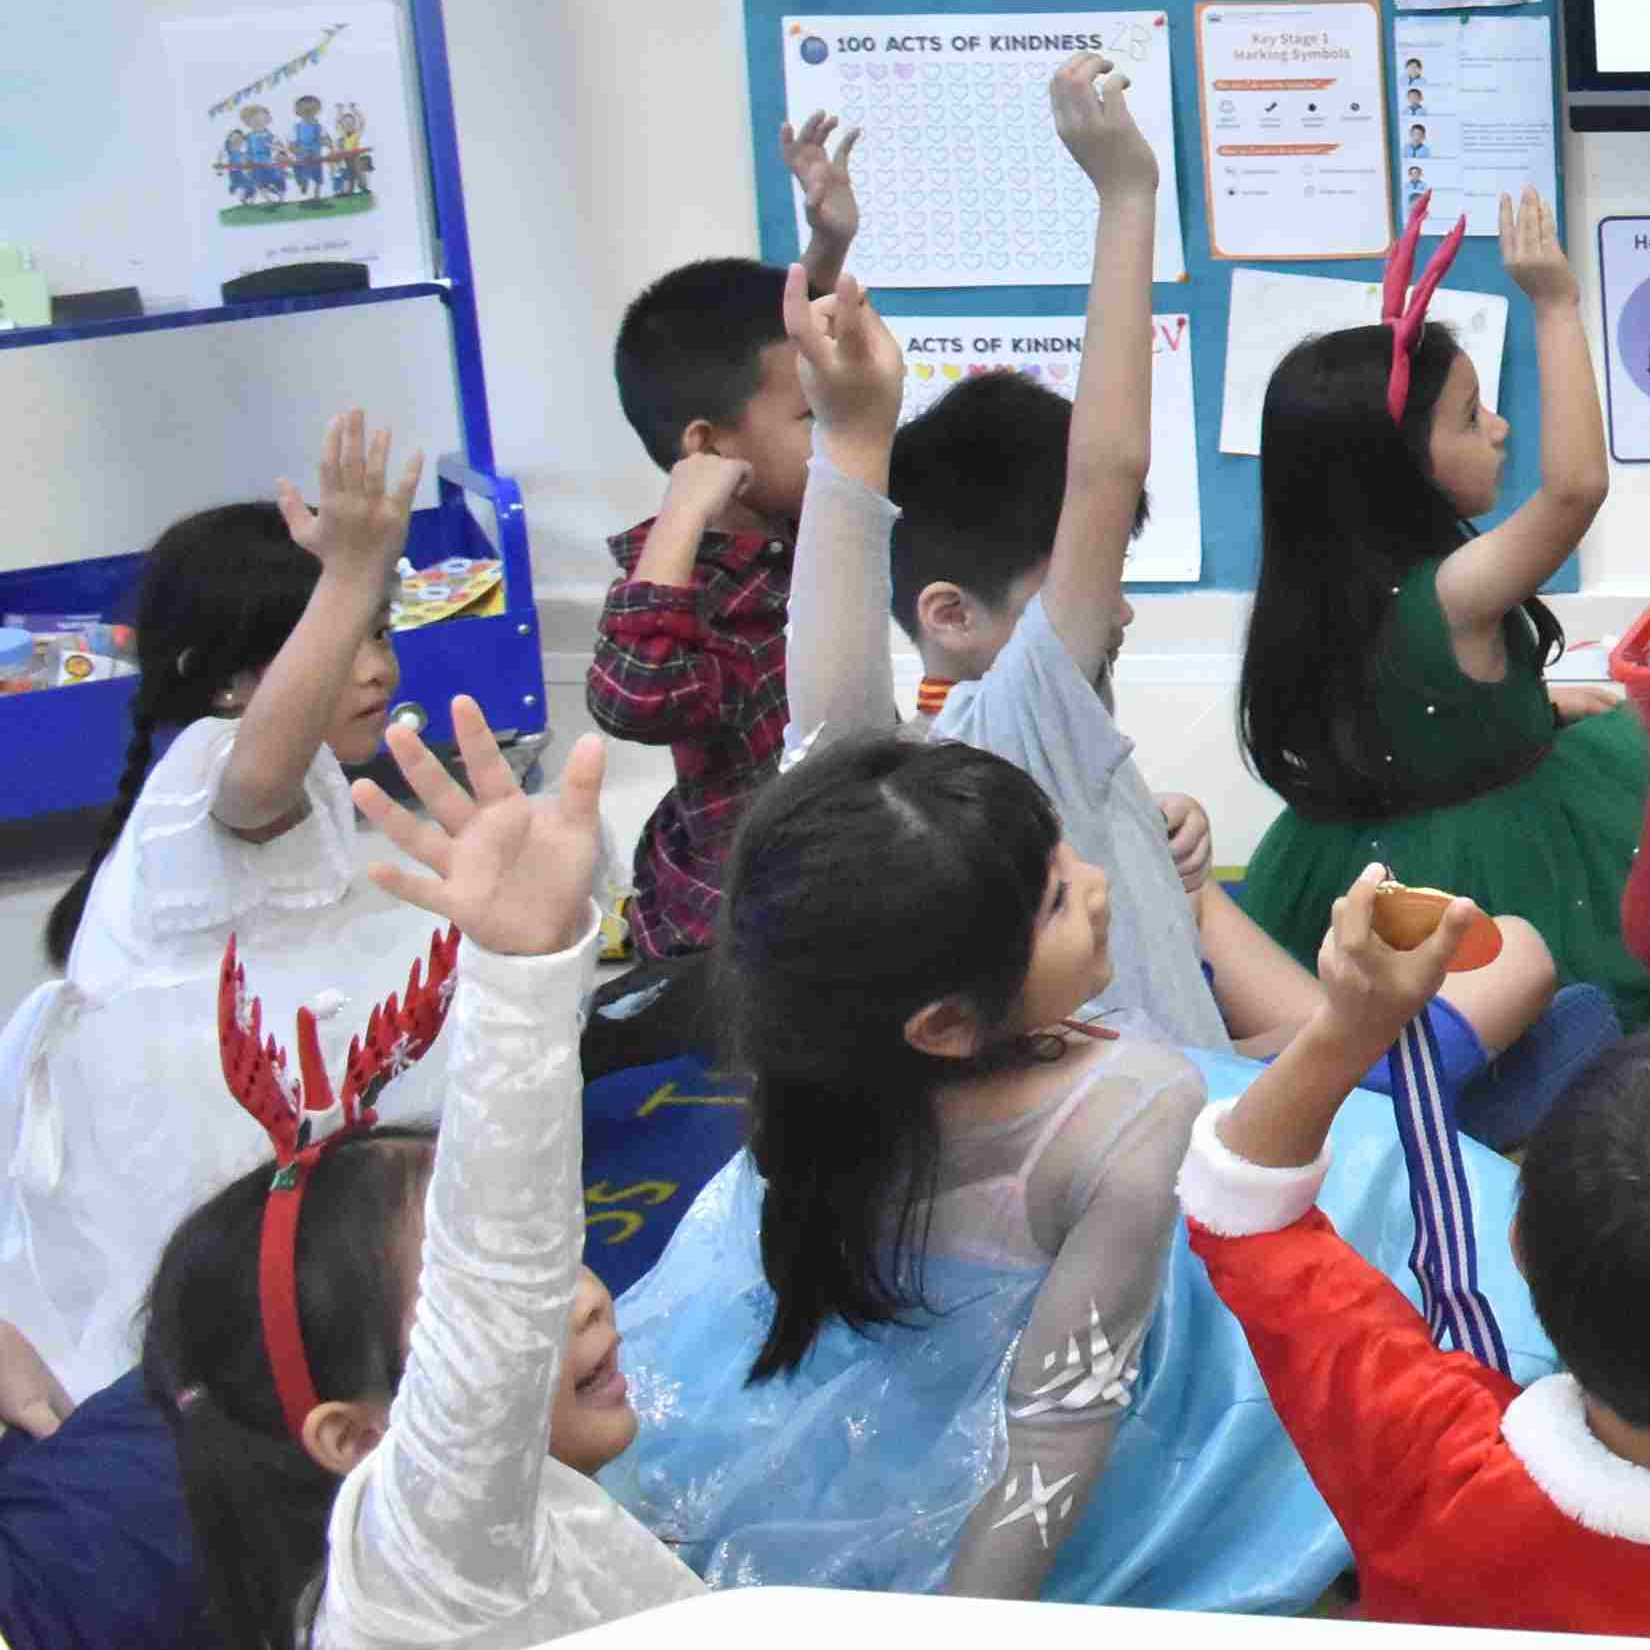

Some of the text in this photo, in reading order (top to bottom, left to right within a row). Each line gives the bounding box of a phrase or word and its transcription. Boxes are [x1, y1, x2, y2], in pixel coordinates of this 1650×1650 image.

[837, 33, 1103, 53] 100 ACTS OF KINDNESS
[1280, 32, 1320, 48] Stage
[1291, 47, 1351, 62] Symbols
[906, 336, 1083, 353] ACTS OF KINDN
